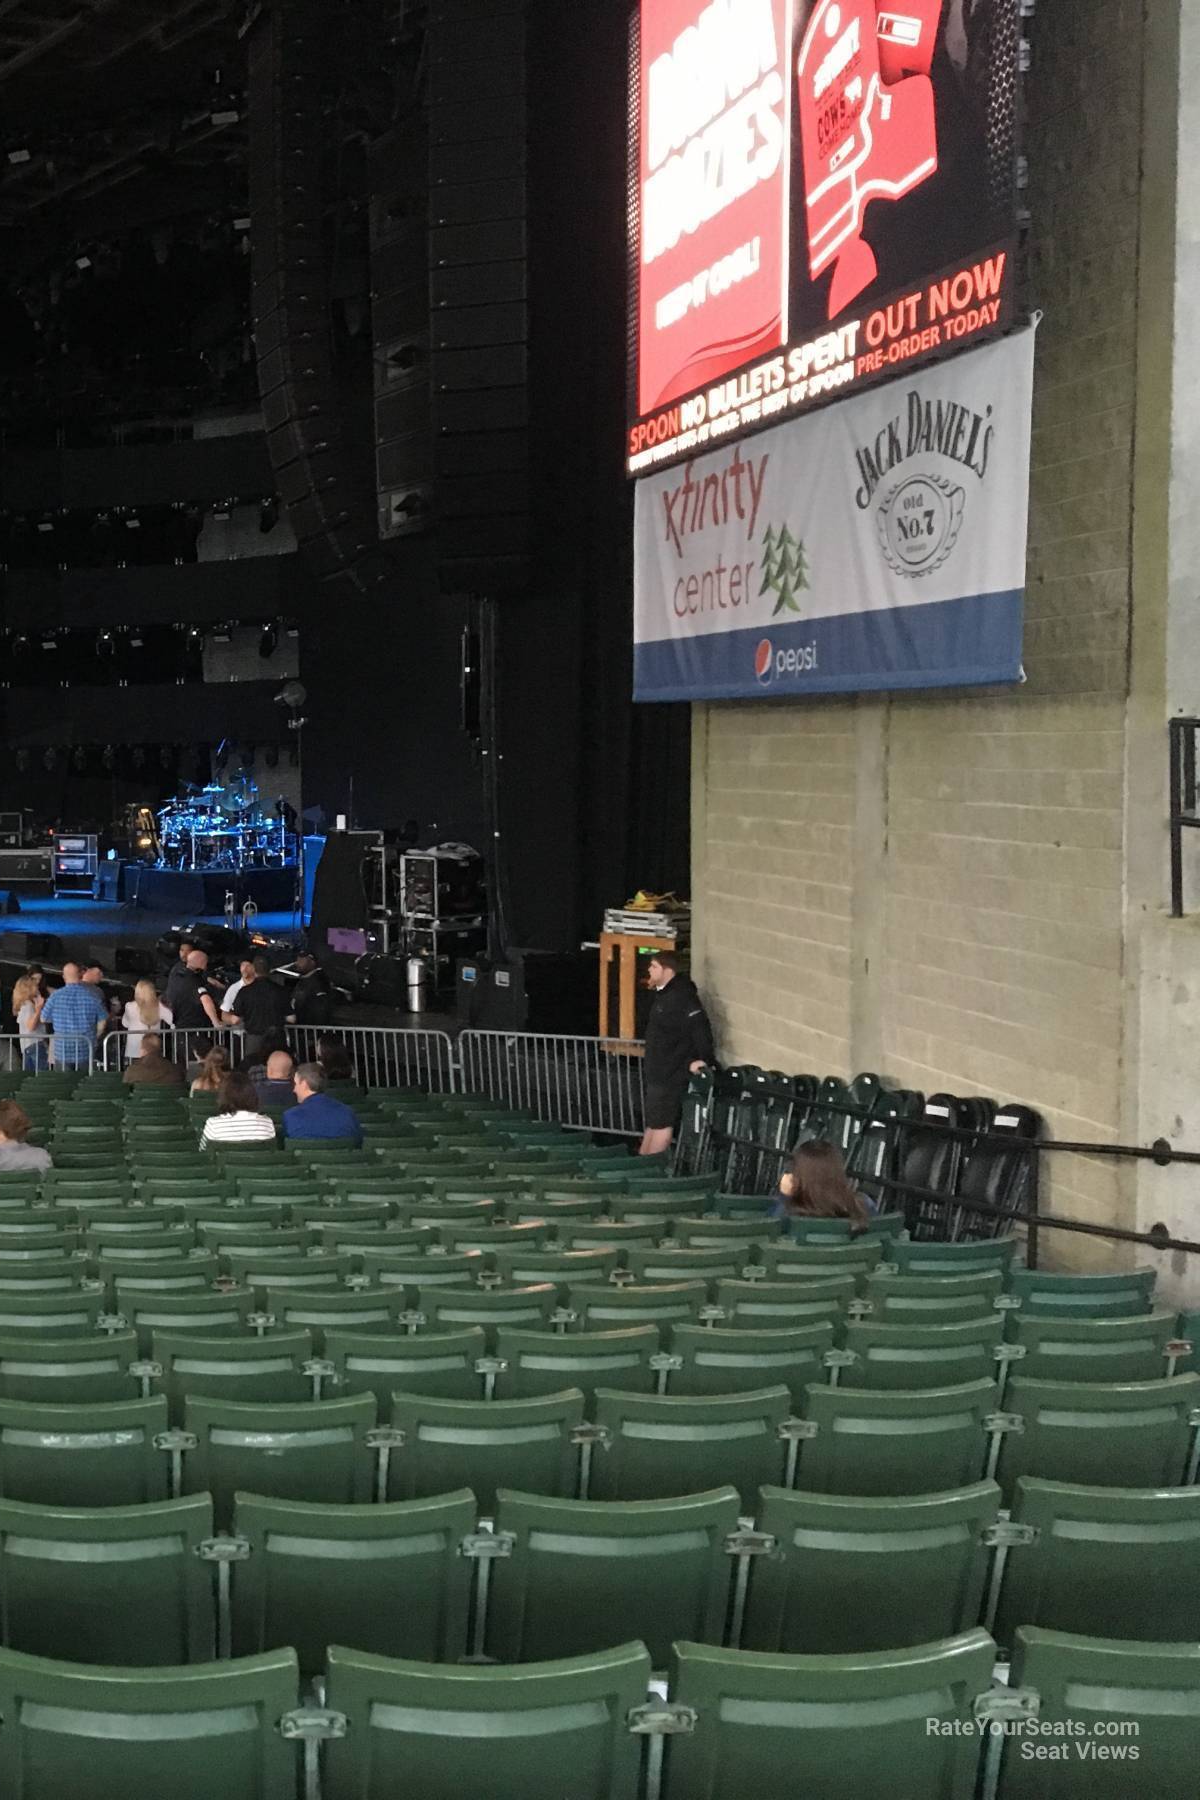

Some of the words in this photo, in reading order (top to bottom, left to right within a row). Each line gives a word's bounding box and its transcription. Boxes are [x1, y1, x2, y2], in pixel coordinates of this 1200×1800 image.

[629, 407, 679, 454] SPOON
[681, 394, 706, 431] NO
[708, 355, 786, 418] BULLETS
[787, 320, 860, 383] SPENT
[865, 292, 922, 346] OUT
[929, 252, 1006, 321] NOW
[856, 326, 940, 376] PRE-ORDER
[943, 299, 1001, 341] TODAY
[662, 445, 770, 559] xfinity
[856, 415, 903, 509] JACK
[673, 552, 755, 618] center
[775, 640, 818, 679] pepsi
